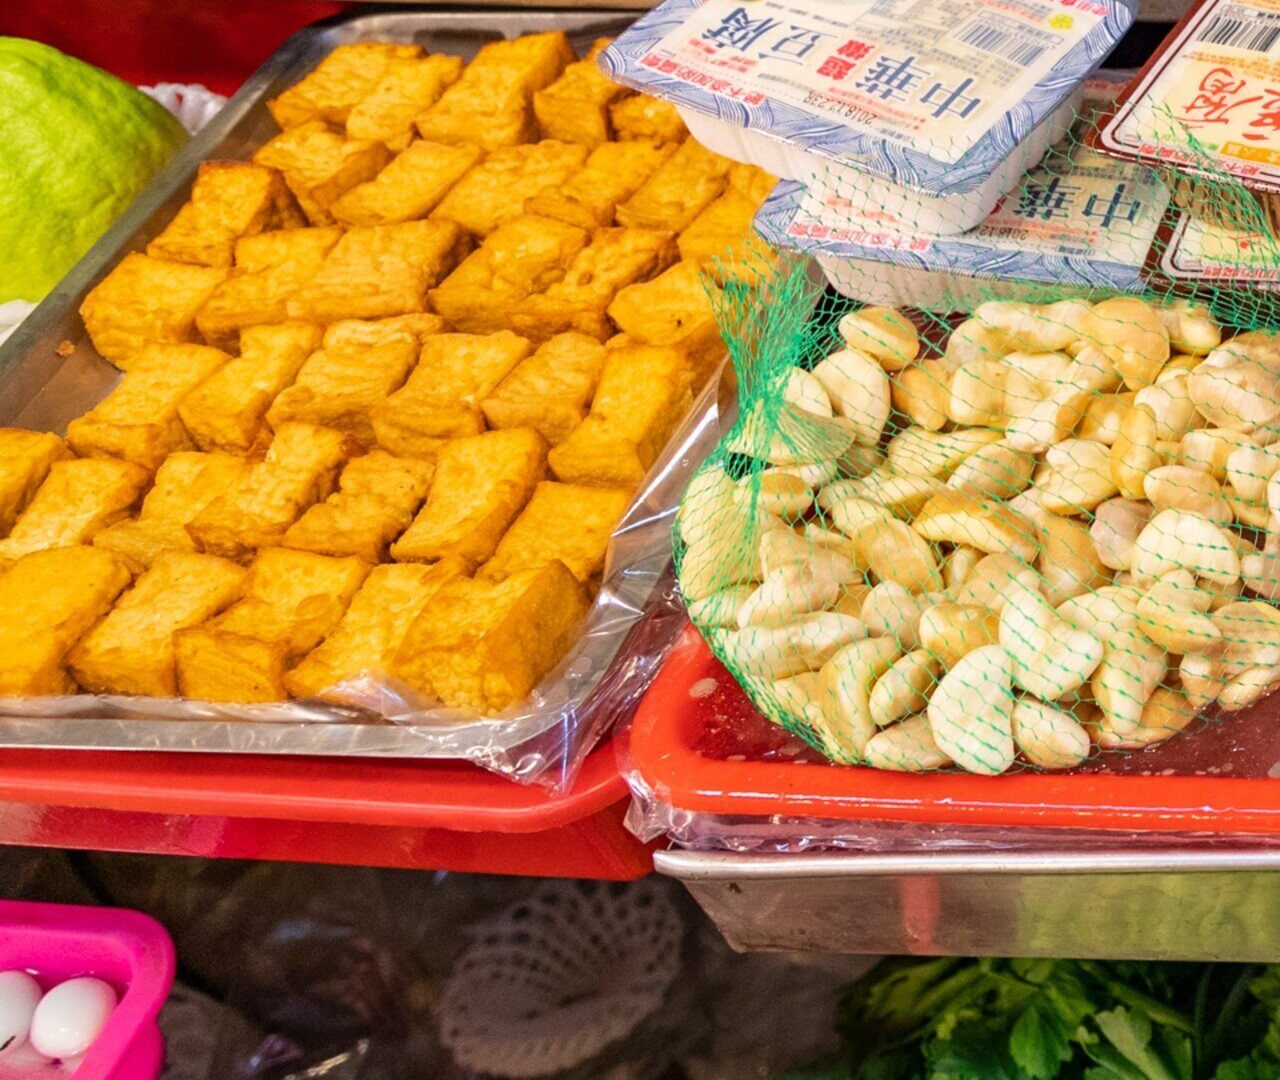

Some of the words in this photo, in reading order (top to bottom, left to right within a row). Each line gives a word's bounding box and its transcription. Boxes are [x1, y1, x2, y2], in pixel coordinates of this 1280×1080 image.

[701, 3, 829, 65] 豆腐
[852, 49, 989, 121] 中華
[1013, 175, 1144, 229] 中華
